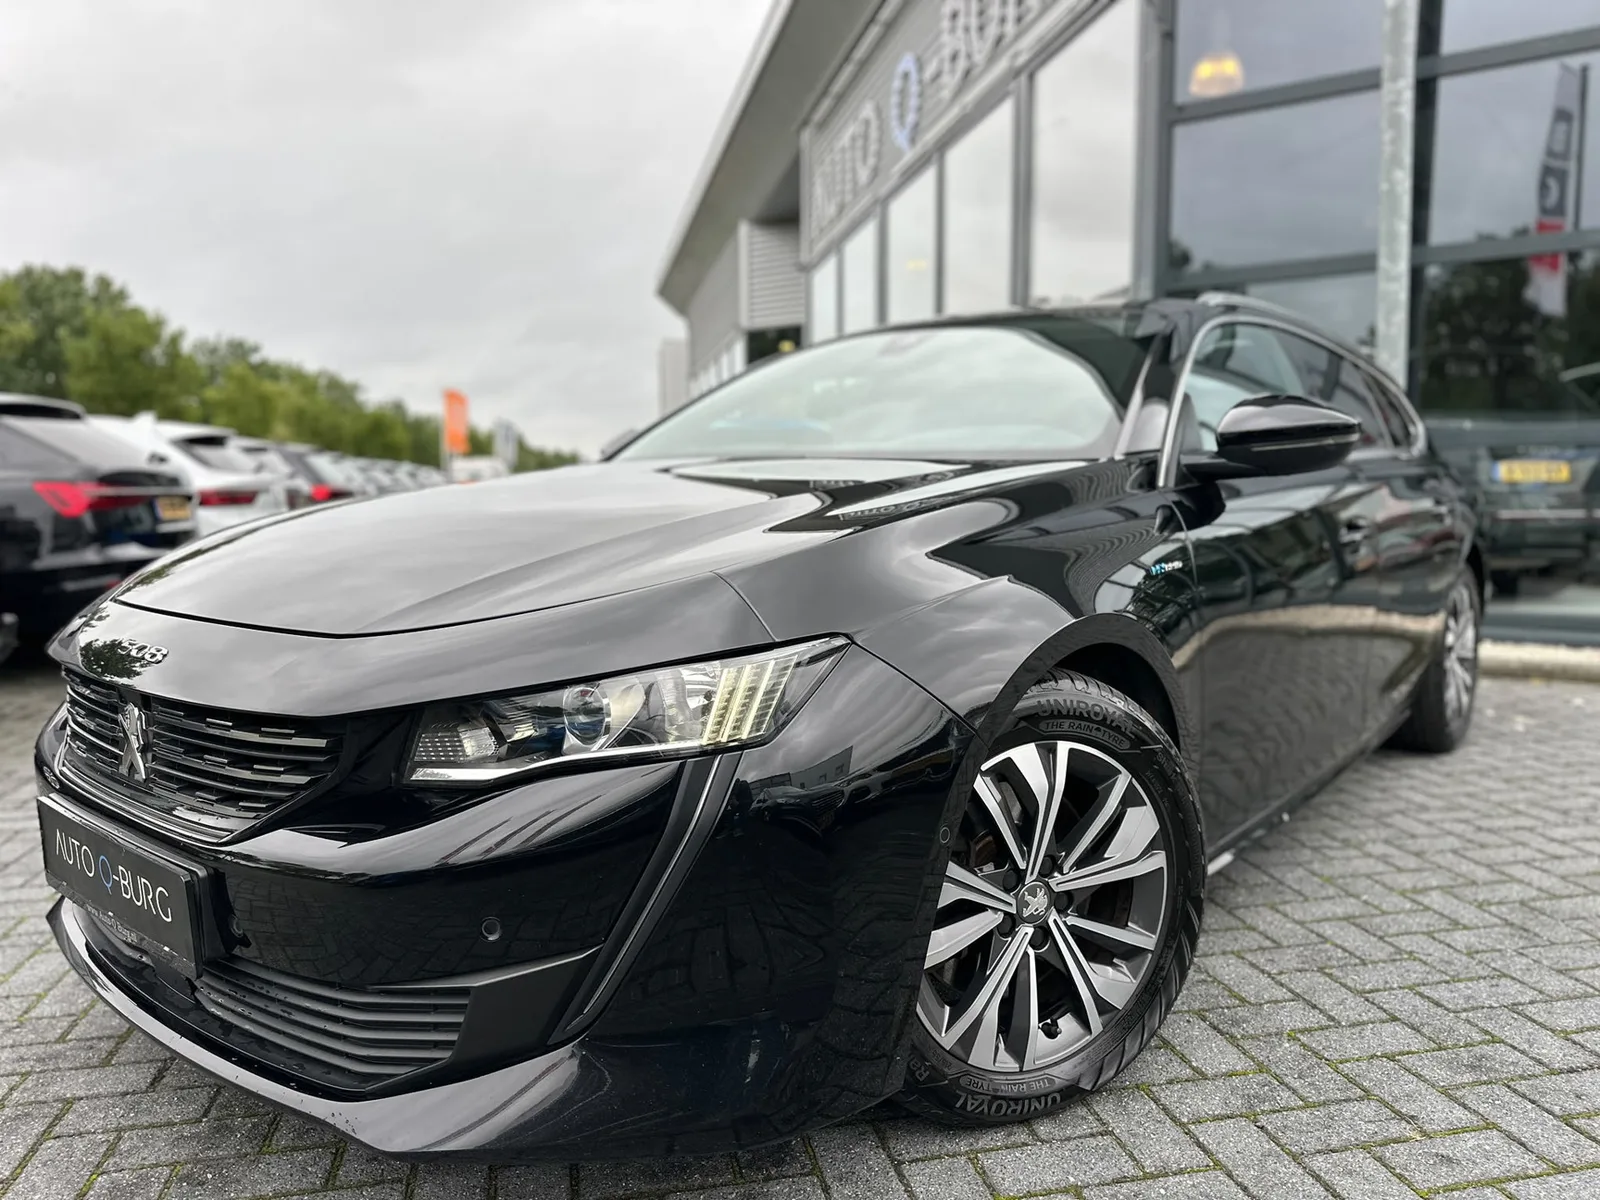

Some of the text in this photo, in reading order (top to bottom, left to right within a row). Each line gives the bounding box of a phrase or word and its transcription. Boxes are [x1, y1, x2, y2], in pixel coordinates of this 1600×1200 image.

[116, 637, 169, 664] 508
[1037, 698, 1135, 738] UNIROYAL
[1045, 721, 1126, 747] THE RAIN TYRE
[56, 828, 172, 923] AUTO Q-BURG
[966, 1078, 1050, 1092] THE RAIN TYRE
[955, 1089, 1061, 1117] UNIROYAL
